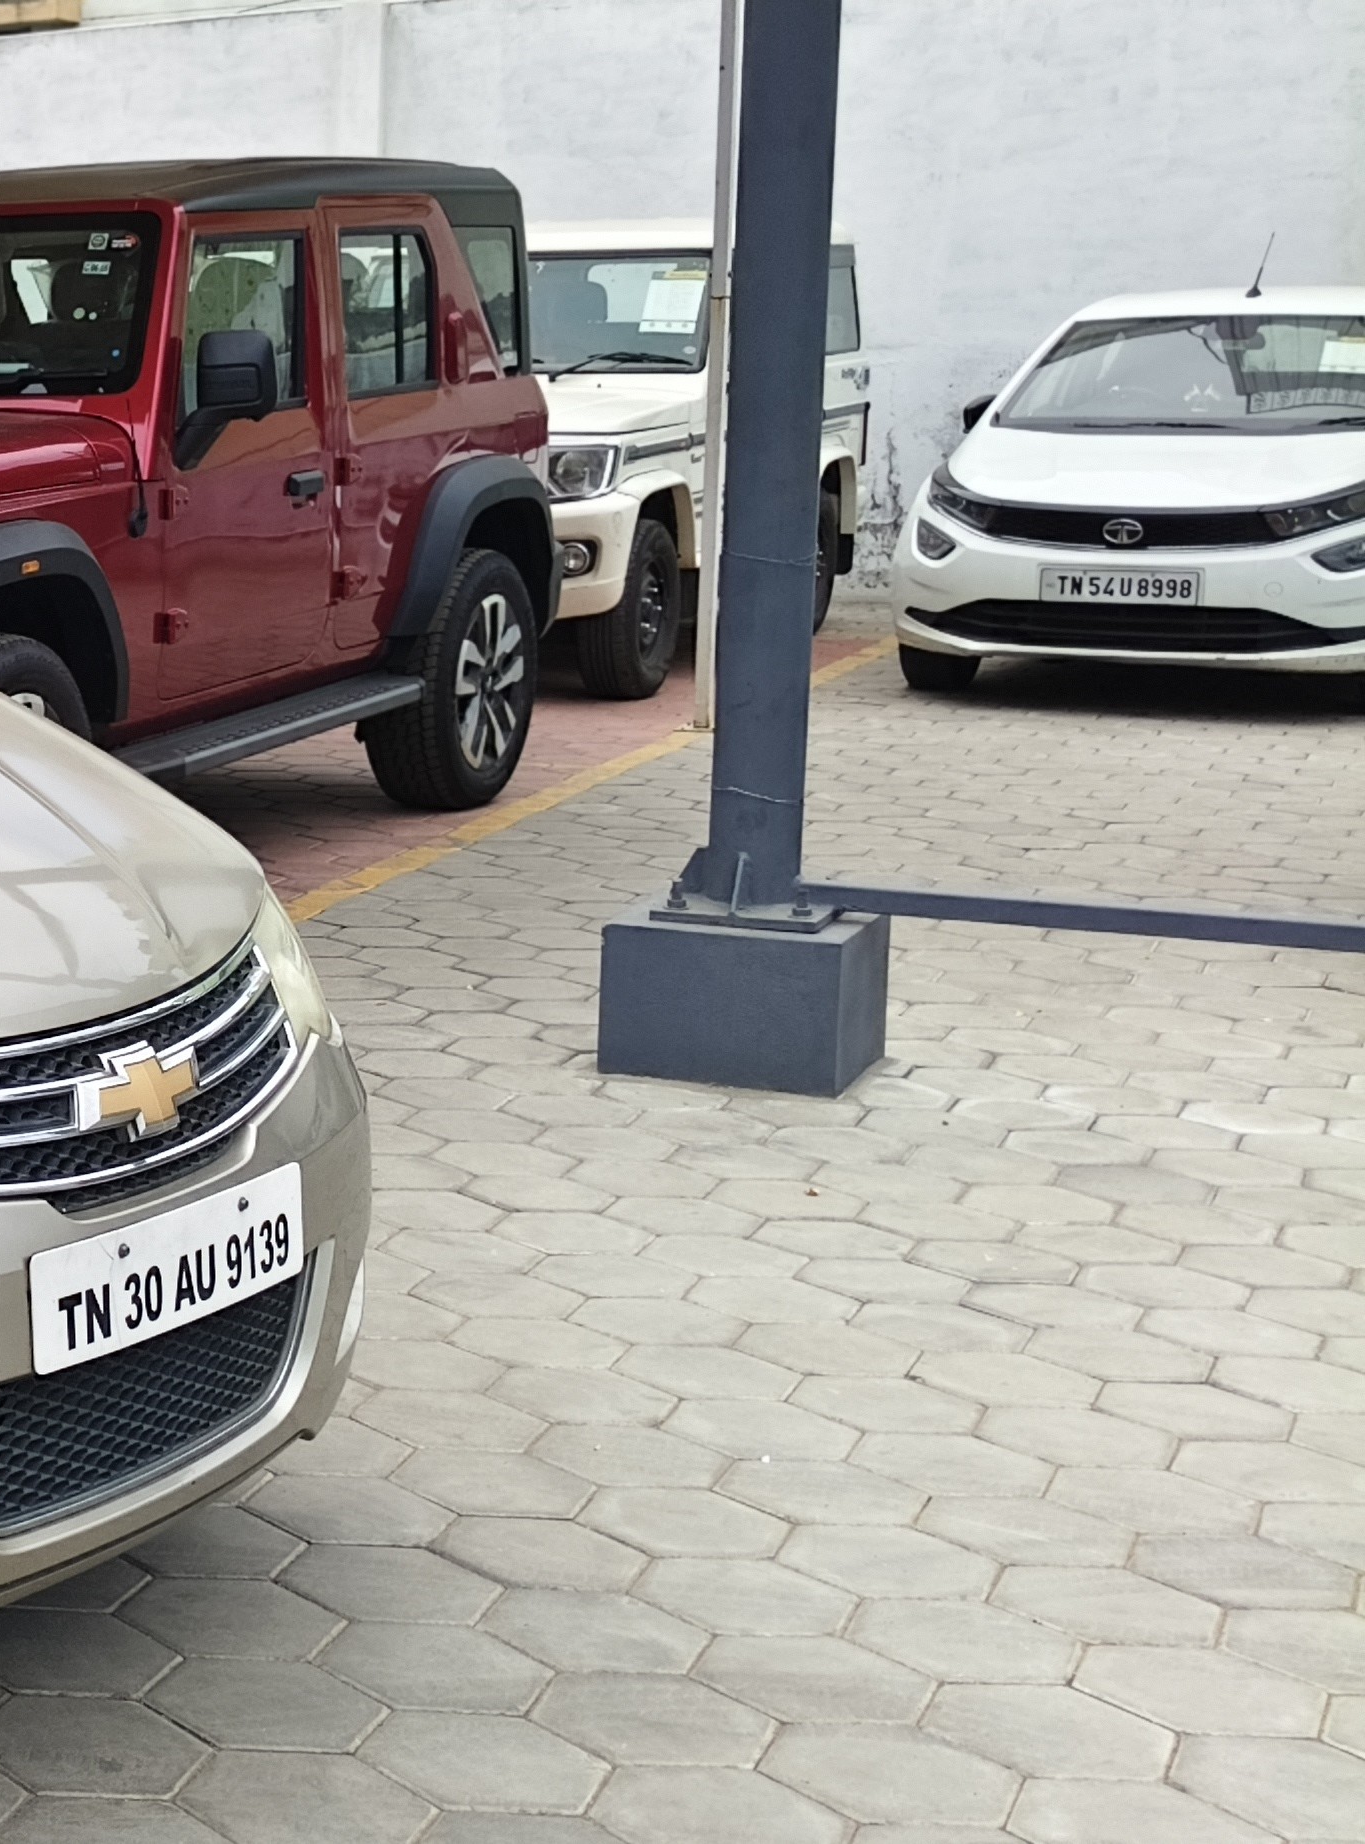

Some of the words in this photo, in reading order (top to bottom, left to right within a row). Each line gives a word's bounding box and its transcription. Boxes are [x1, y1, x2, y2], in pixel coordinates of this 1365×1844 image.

[1058, 575, 1083, 596] TN
[1088, 577, 1115, 597] 54
[1120, 578, 1133, 597] U
[1137, 578, 1192, 599] 8998
[58, 1283, 112, 1351] TN
[124, 1265, 163, 1330] 30
[174, 1243, 216, 1312] AU
[226, 1213, 289, 1289] 9139
